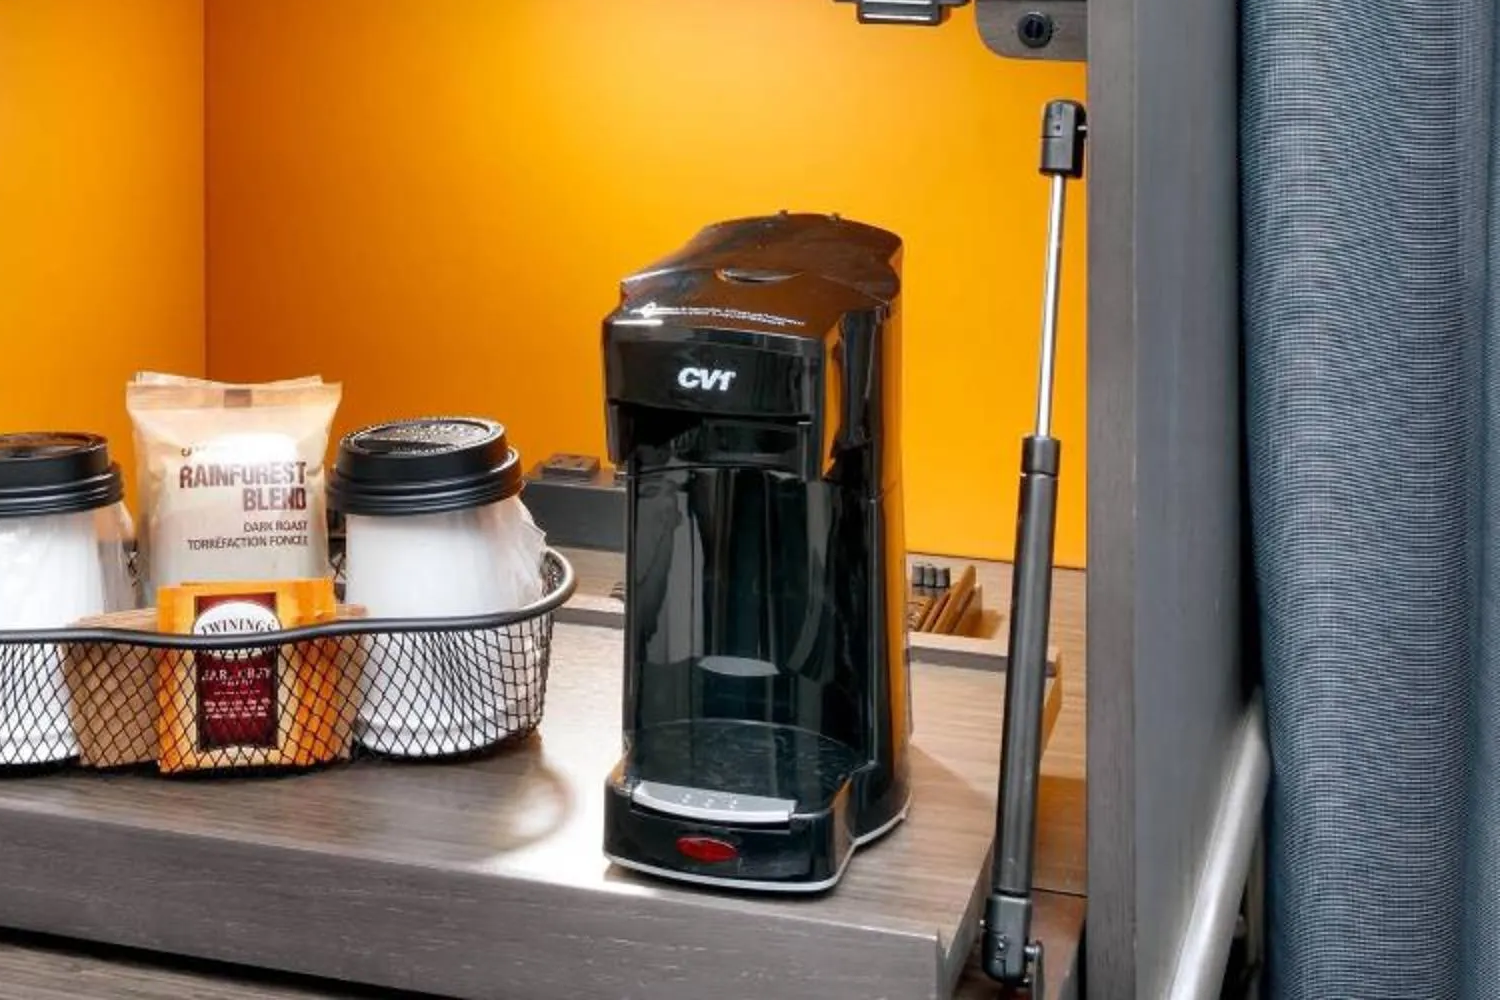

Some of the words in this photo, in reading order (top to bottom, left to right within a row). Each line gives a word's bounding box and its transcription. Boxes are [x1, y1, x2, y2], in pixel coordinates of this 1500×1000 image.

[180, 461, 307, 488] RAINFOREST
[243, 487, 306, 512] BLEND
[243, 522, 273, 532] DARK
[275, 520, 308, 531] ROAST
